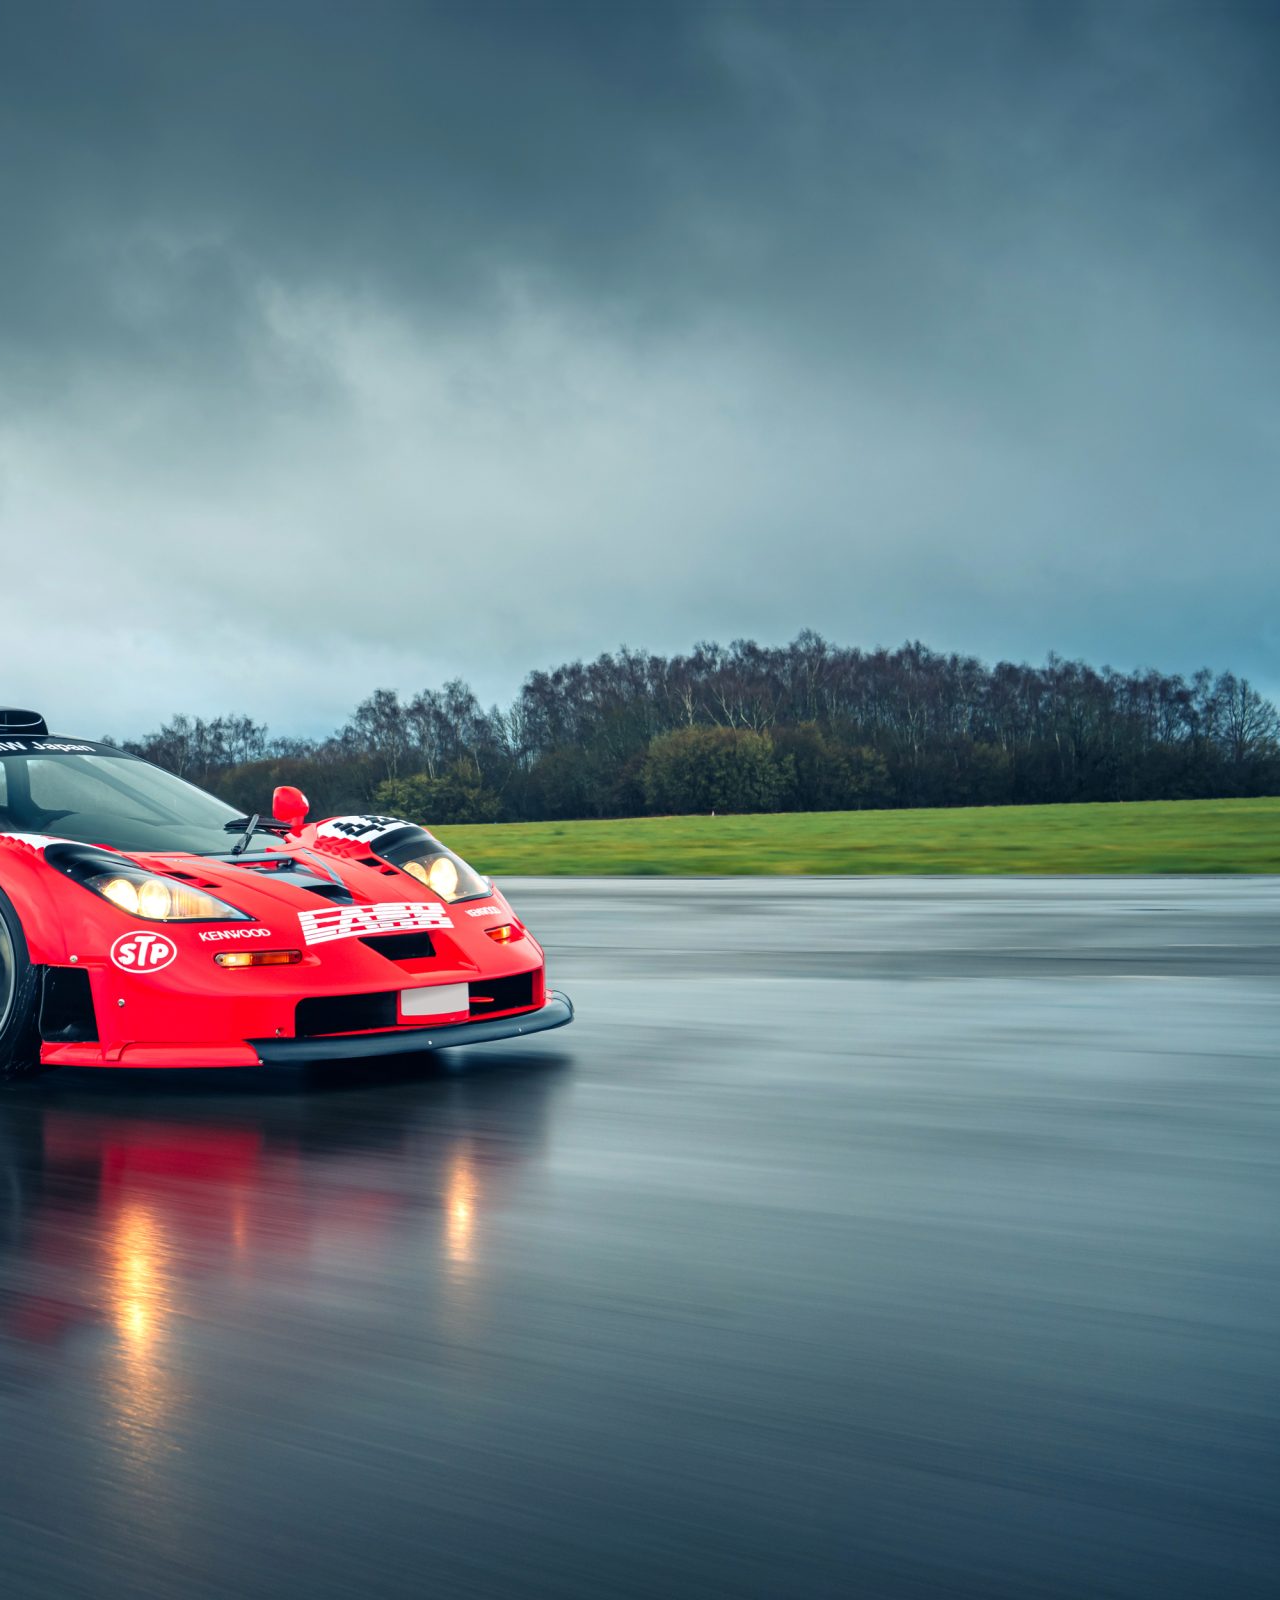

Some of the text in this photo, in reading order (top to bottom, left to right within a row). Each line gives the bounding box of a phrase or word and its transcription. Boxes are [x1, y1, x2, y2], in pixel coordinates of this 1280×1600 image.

[32, 741, 96, 752] Japan
[198, 928, 271, 942] KENWOOD
[118, 936, 169, 966] STP
